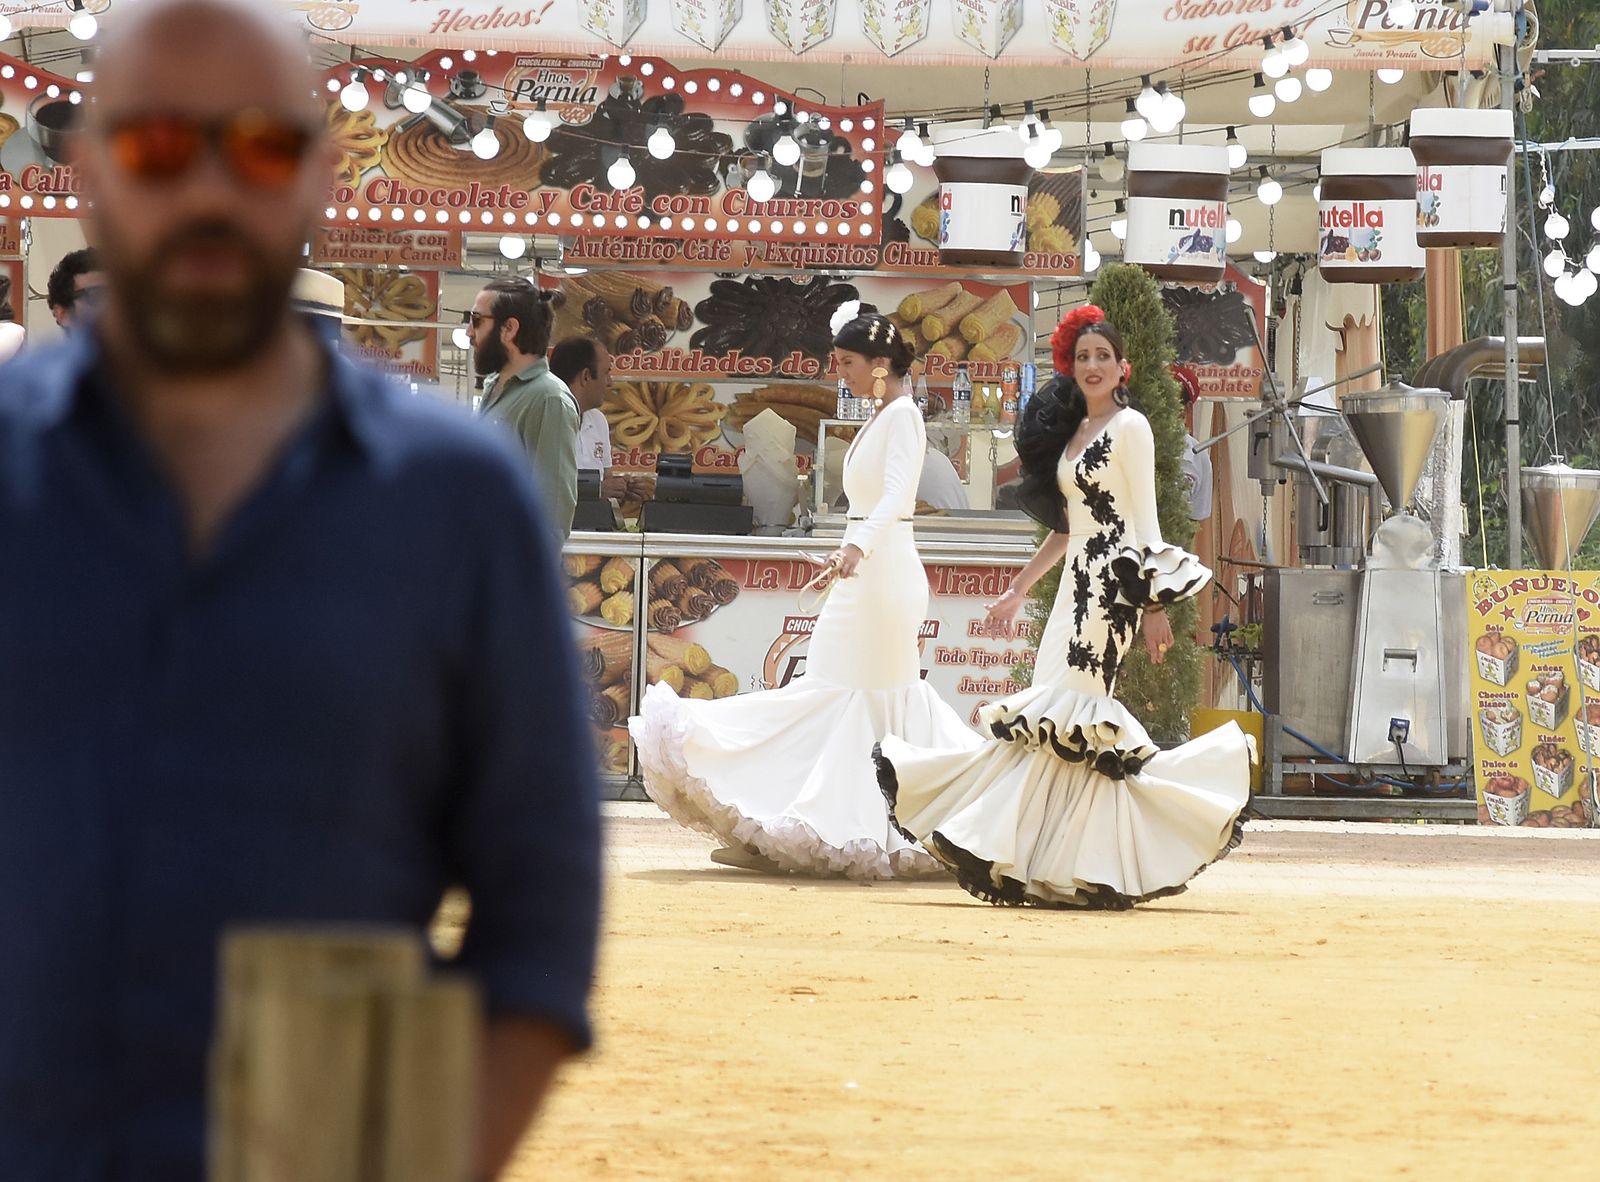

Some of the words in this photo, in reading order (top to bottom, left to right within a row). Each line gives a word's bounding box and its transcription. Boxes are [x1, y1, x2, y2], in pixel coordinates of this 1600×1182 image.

[429, 1, 554, 33] Hechos!
[1183, 35, 1216, 54] su
[1223, 16, 1318, 49] Guso!
[537, 69, 572, 84] Hnos.
[512, 79, 598, 104] Pernía
[365, 178, 529, 209] Chocolate
[538, 190, 562, 216] y
[569, 184, 644, 213] Café
[652, 195, 711, 215] con
[722, 189, 860, 219] Churros
[328, 230, 413, 244] Cubiertos
[418, 235, 448, 246] con
[321, 244, 378, 259] Azúcar
[383, 249, 394, 262] y
[400, 246, 457, 261] Canela
[569, 236, 676, 261] Auténtico
[682, 239, 732, 261] Café
[743, 244, 759, 268] y
[764, 240, 878, 268] Exquisitos
[883, 241, 944, 267] Chur
[780, 350, 820, 376] de
[743, 559, 780, 591] La
[1474, 577, 1600, 617] BUÑUELO
[936, 648, 967, 665] Todo
[971, 649, 999, 668] Tipo
[1002, 651, 1019, 666] de
[959, 677, 1001, 695] Javier
